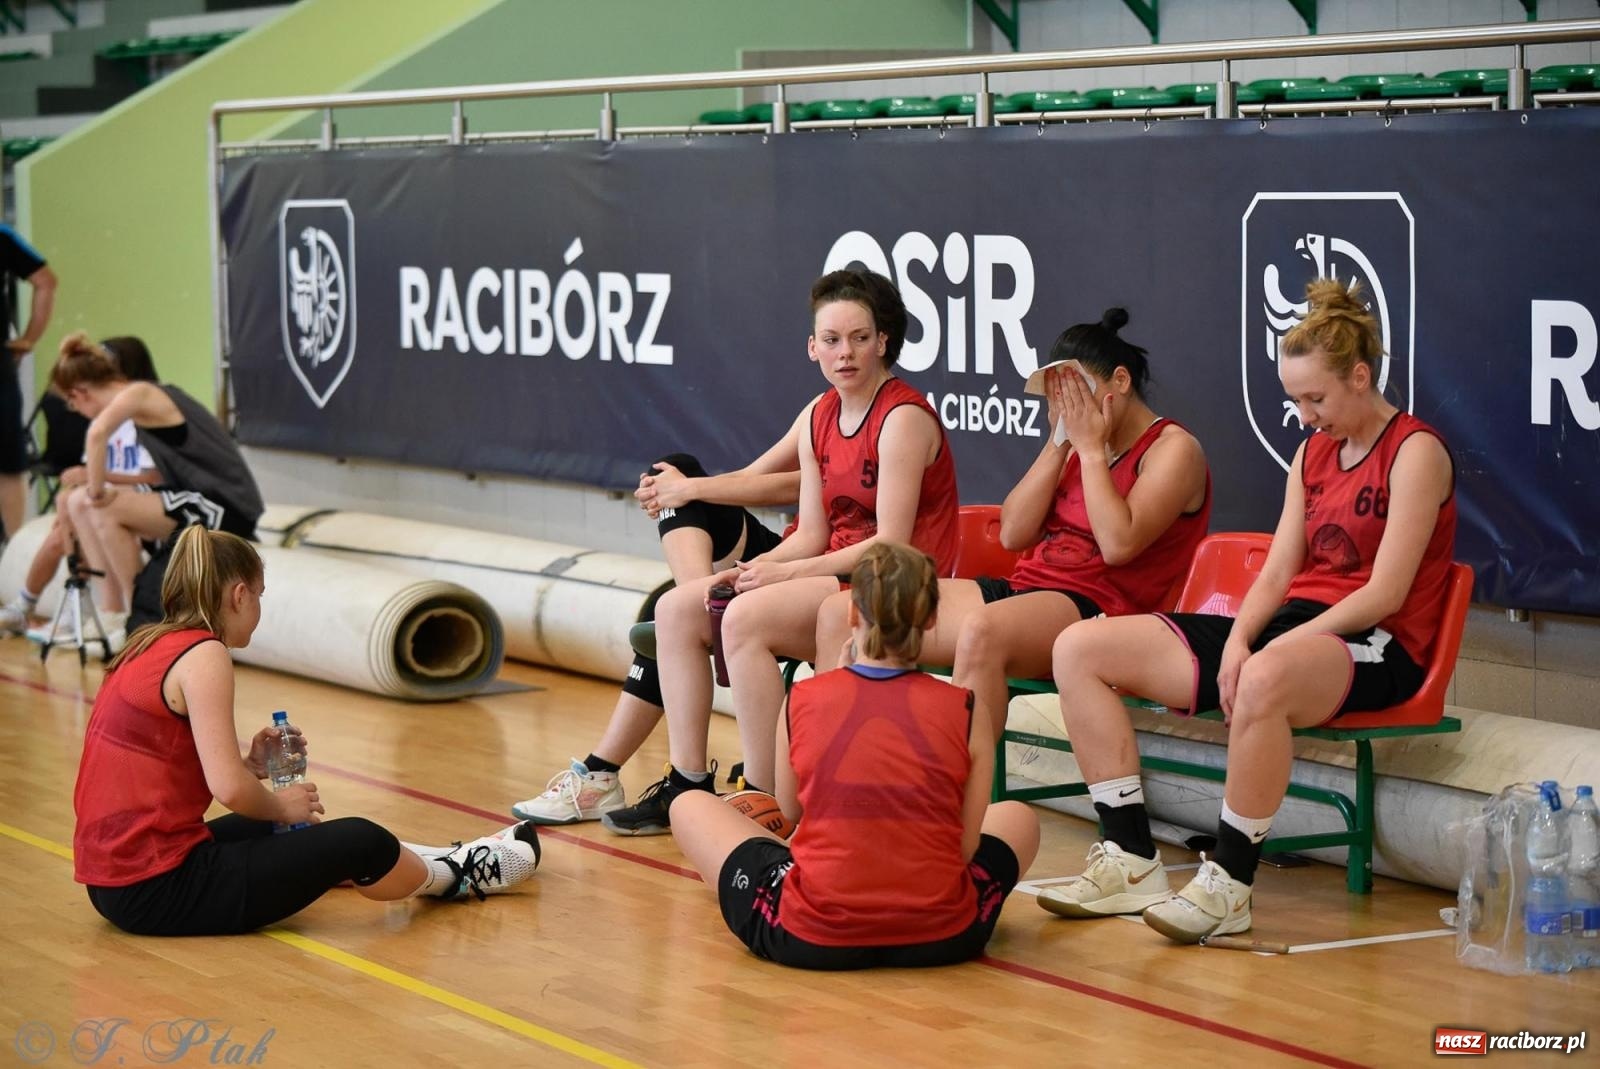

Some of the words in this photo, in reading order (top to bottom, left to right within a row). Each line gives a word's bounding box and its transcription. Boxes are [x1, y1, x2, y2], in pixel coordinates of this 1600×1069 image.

[400, 236, 674, 366] RACIBÓRZ
[925, 383, 1041, 438] CIBÓRZ
[1354, 484, 1390, 519] 66
